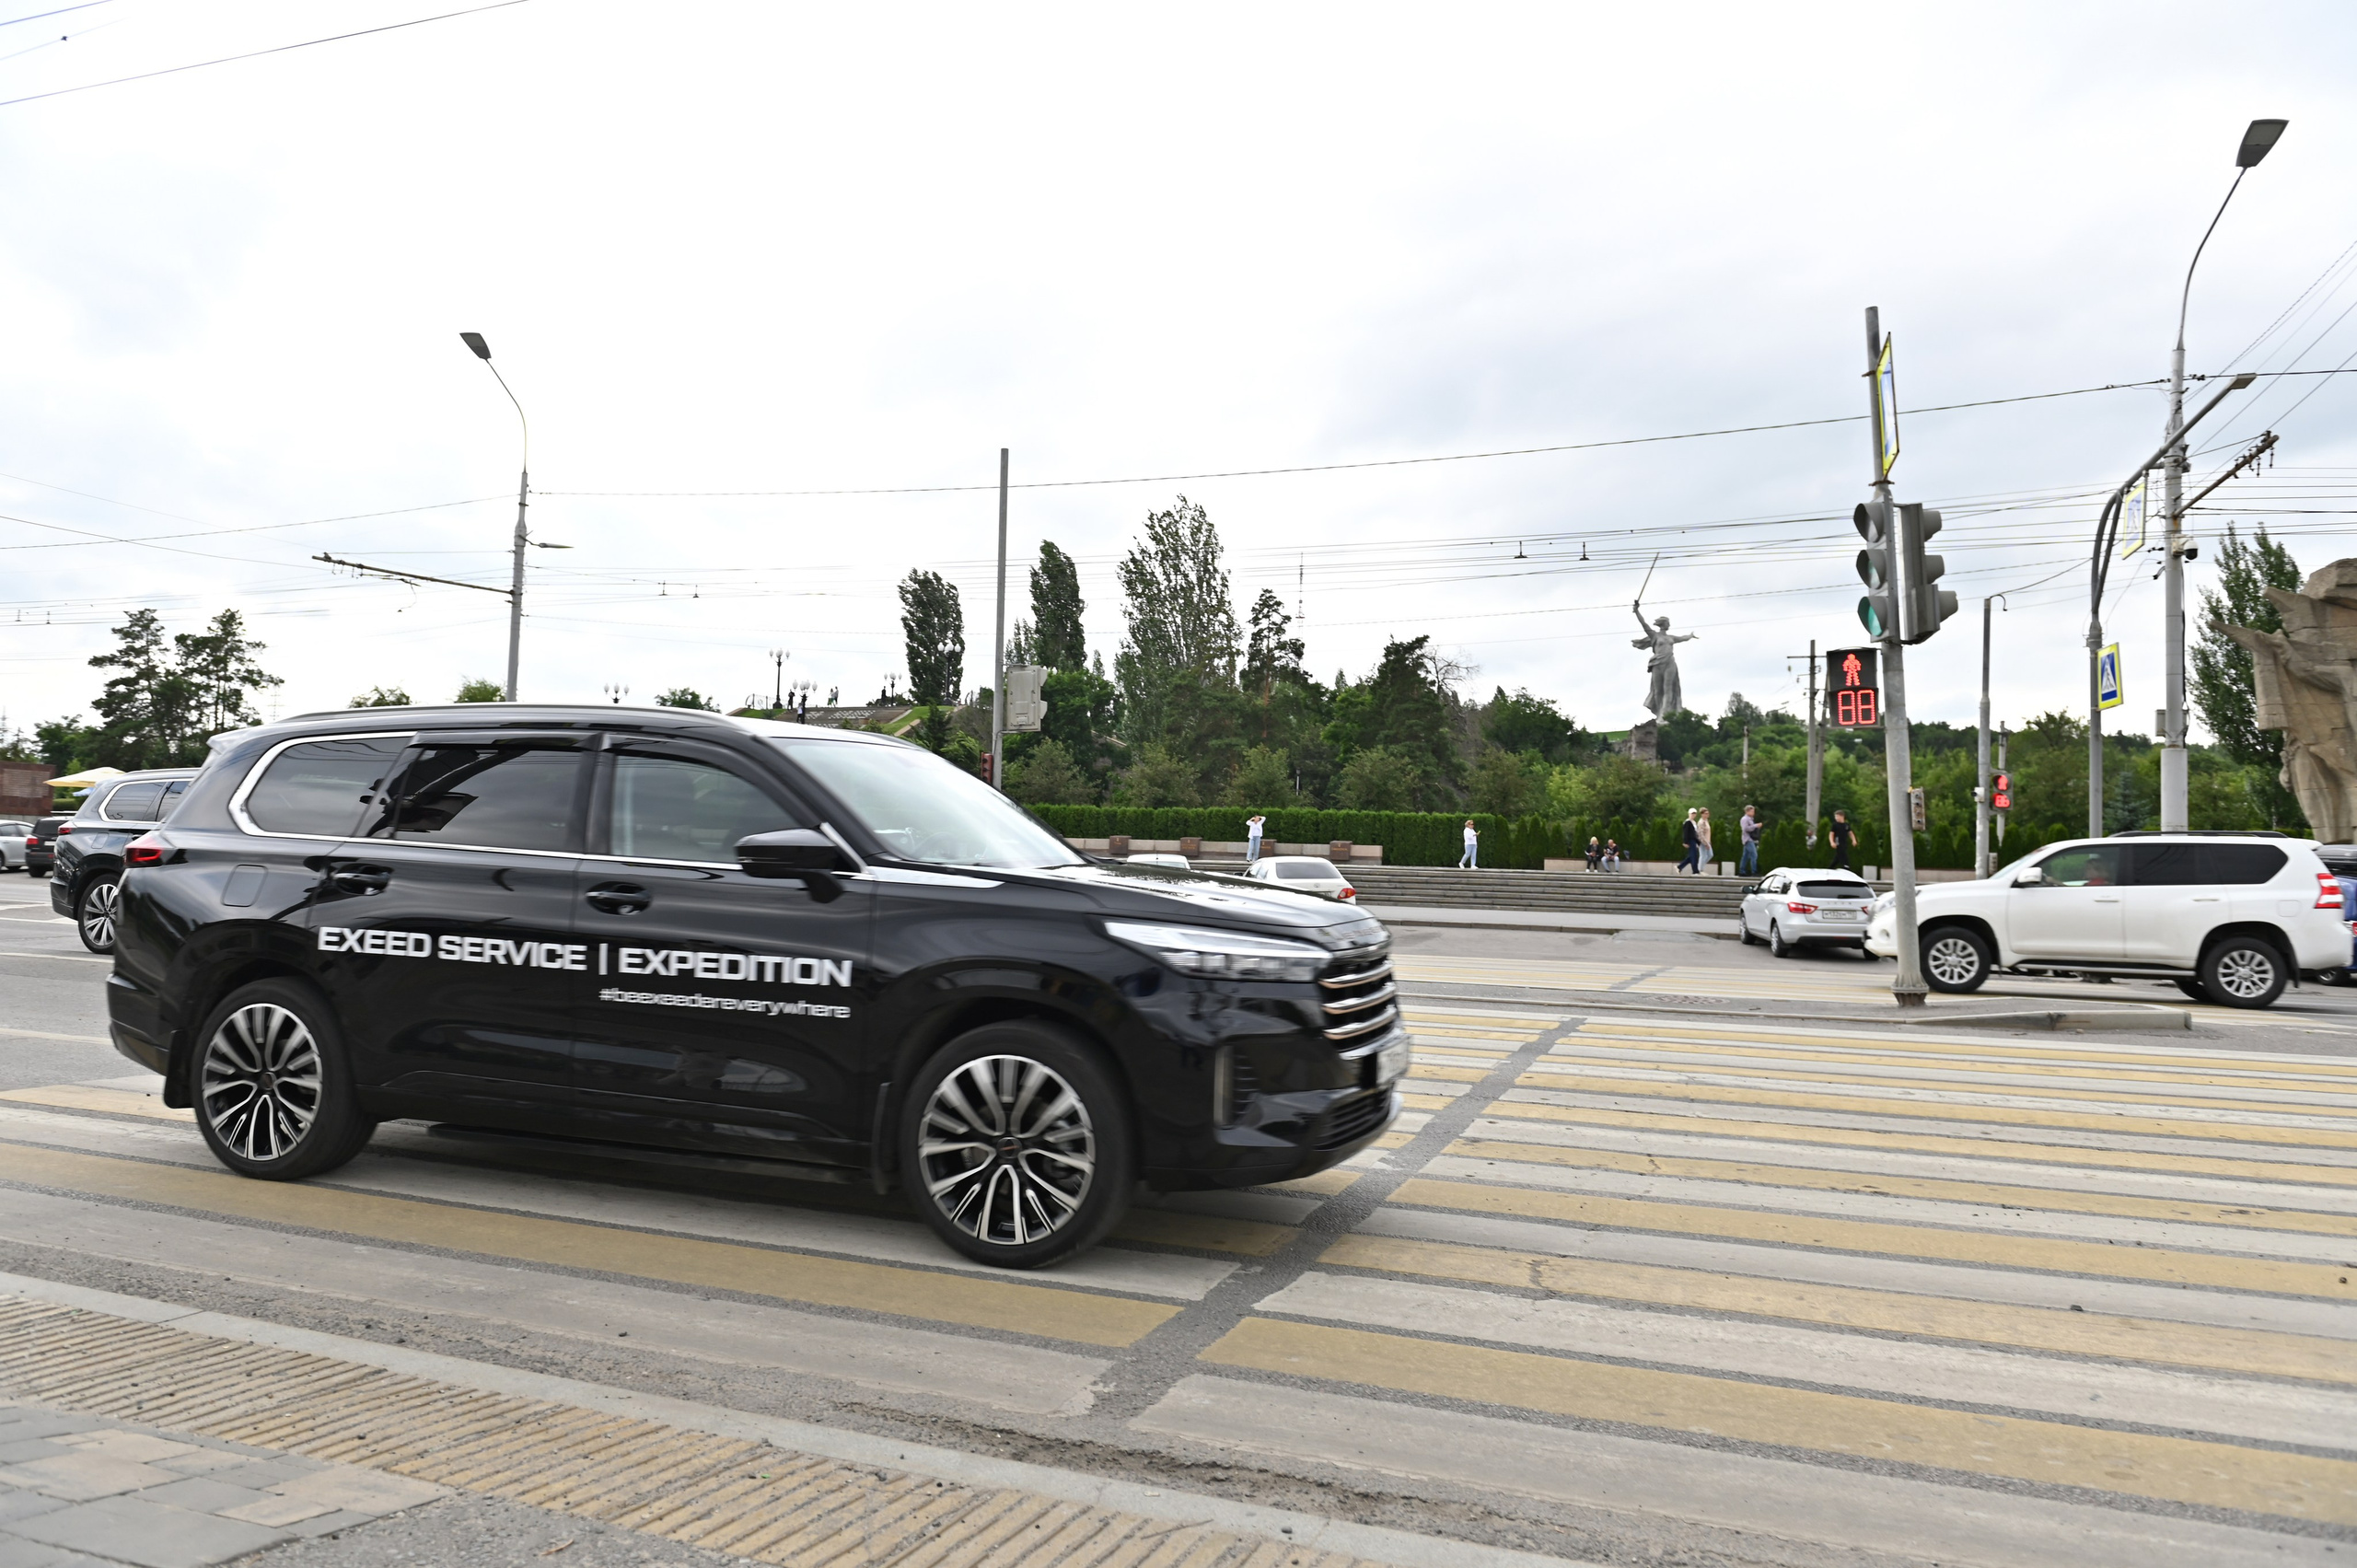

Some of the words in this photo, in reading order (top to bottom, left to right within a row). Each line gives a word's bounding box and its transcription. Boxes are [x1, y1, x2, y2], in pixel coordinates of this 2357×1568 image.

[1837, 690, 1875, 726] 88
[318, 926, 431, 958] EXEED
[438, 935, 586, 971] SERVICE
[618, 947, 853, 987] EXPEDITION
[599, 987, 852, 1018] #beexeedereverywhere
